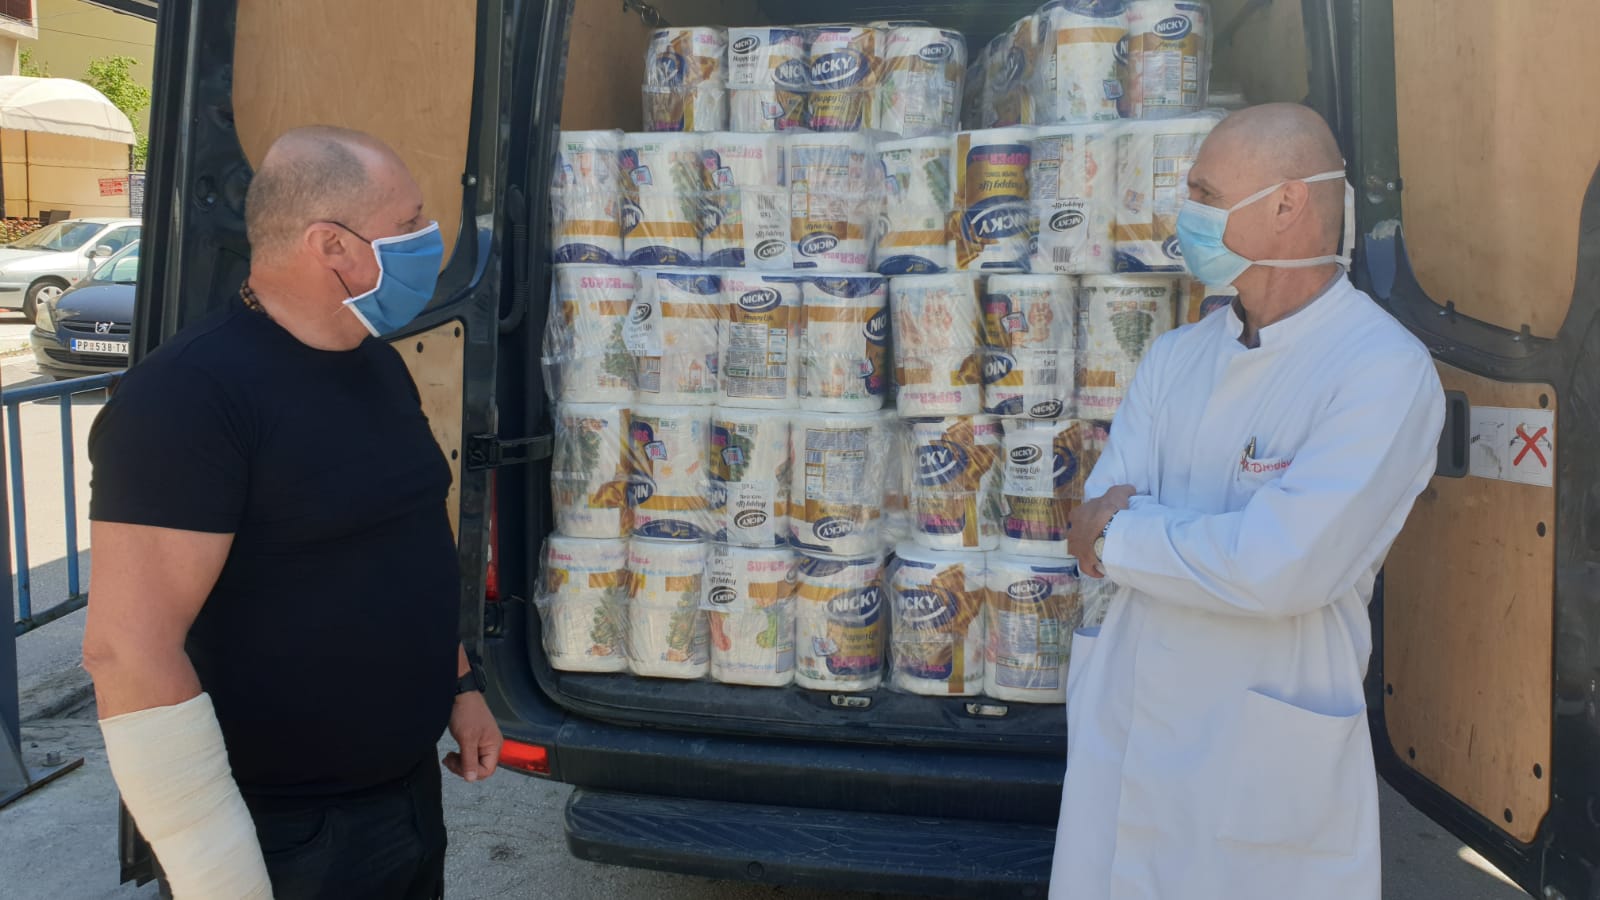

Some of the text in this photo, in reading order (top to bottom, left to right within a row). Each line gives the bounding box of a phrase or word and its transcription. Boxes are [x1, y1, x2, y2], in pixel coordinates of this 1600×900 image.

[1156, 18, 1184, 32] NICKY
[734, 37, 755, 49] NICKY
[922, 46, 947, 57] NICKY
[779, 63, 801, 79] NIC
[811, 56, 852, 78] NICKY
[1056, 217, 1081, 229] NICKY
[762, 243, 785, 256] NICKY
[807, 239, 835, 252] NICKY
[580, 276, 622, 289] SUPER
[742, 292, 771, 304] NICKY
[985, 357, 1008, 376] NIC
[920, 391, 962, 404] SUPER
[1032, 402, 1057, 414] NICKY
[919, 448, 949, 467] CKY
[1011, 449, 1034, 458] NICKY
[742, 513, 767, 526] NICKY
[822, 523, 852, 537] NICKY
[747, 560, 785, 572] SUPER
[1010, 584, 1040, 594] NICKY
[832, 588, 879, 613] NICKY
[901, 594, 938, 611] ICKY
